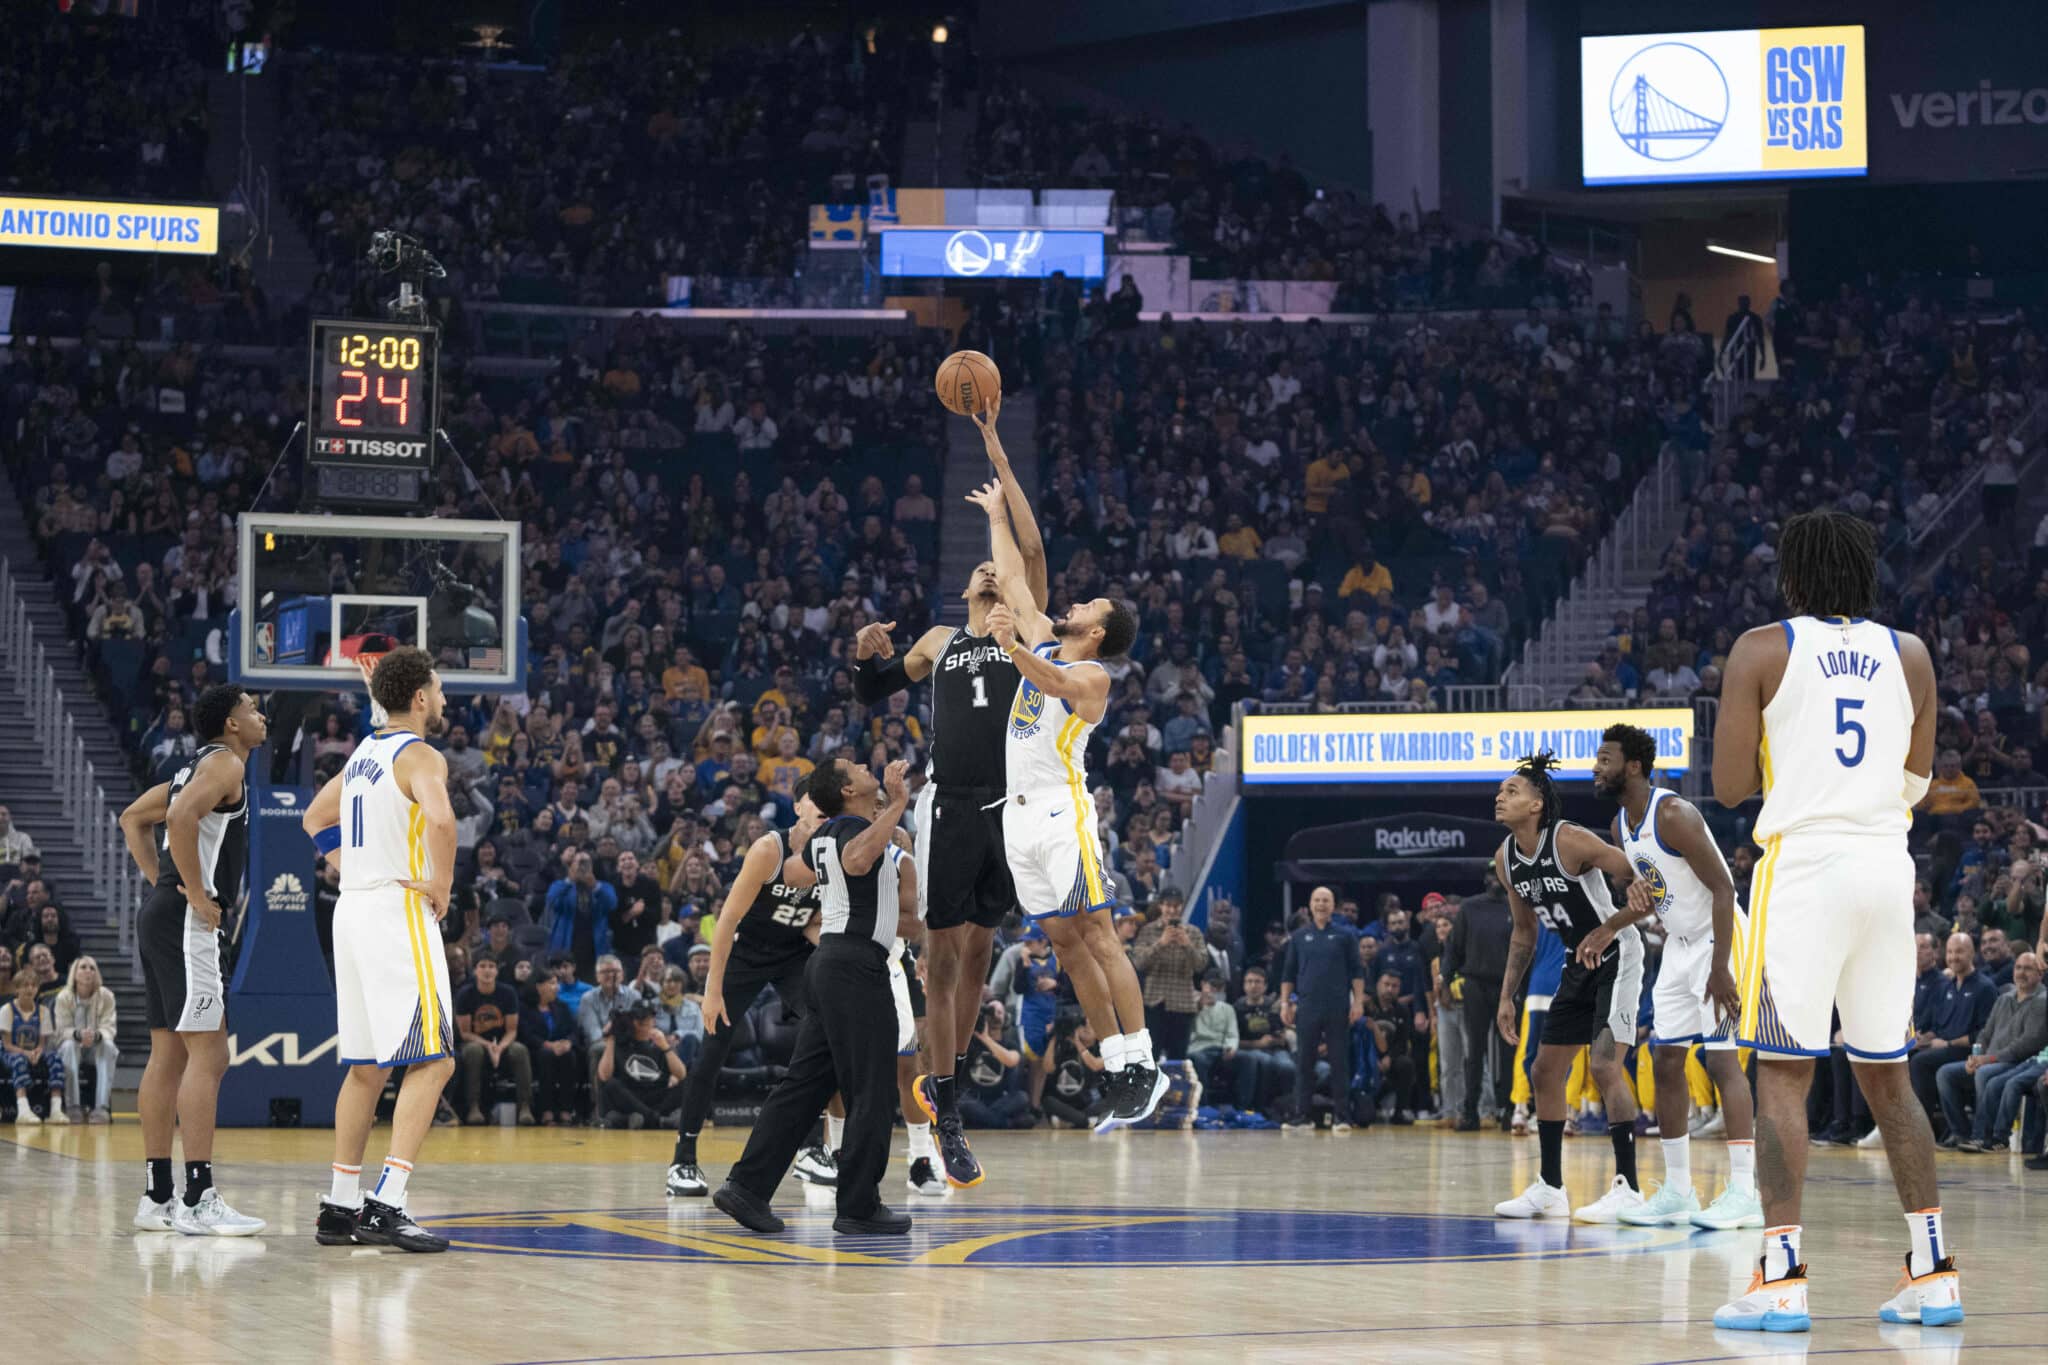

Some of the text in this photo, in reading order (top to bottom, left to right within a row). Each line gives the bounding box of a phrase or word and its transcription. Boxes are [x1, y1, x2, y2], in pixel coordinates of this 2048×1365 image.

[1767, 45, 1846, 105] GSW
[1767, 105, 1843, 151] VS SAS
[0, 208, 201, 244] ANTONIO SPURS
[340, 334, 420, 371] 12:00
[335, 370, 409, 427] 24
[347, 440, 426, 458] TISSOT
[1816, 650, 1882, 682] LOONEY
[971, 675, 989, 708] 1
[1027, 689, 1042, 708] 30
[1253, 733, 1320, 764] GOLDEN
[1325, 732, 1374, 763] STATE
[1380, 731, 1475, 762] WARRIORS
[1500, 730, 1535, 761] SAN
[1541, 729, 1604, 759] ANTON
[1834, 697, 1867, 768] 5
[259, 808, 305, 817] DOORDAS
[351, 793, 364, 848] 11
[1376, 826, 1465, 850] Rakuten
[772, 904, 814, 927] 23
[1534, 903, 1573, 929] 24
